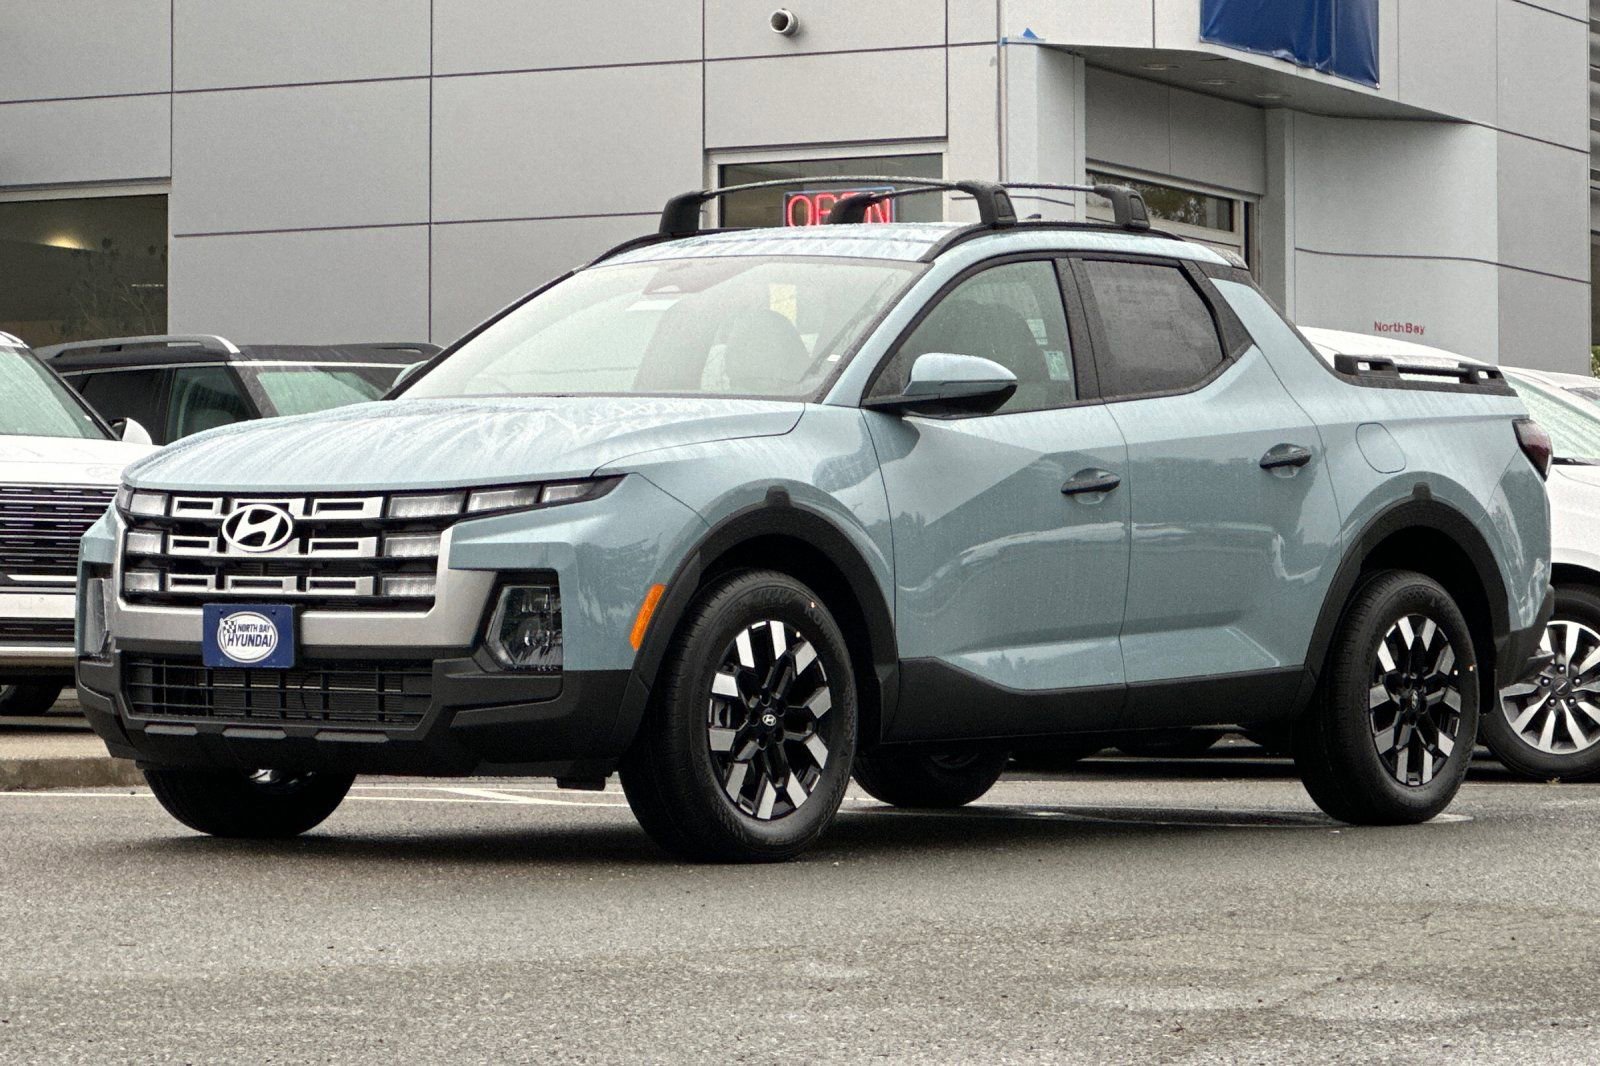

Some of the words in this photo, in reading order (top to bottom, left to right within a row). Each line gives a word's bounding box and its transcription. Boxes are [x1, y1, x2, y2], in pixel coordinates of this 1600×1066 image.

[237, 623, 258, 633] NORTH
[258, 623, 271, 633] BAY
[226, 633, 273, 648] HYUNDAI
